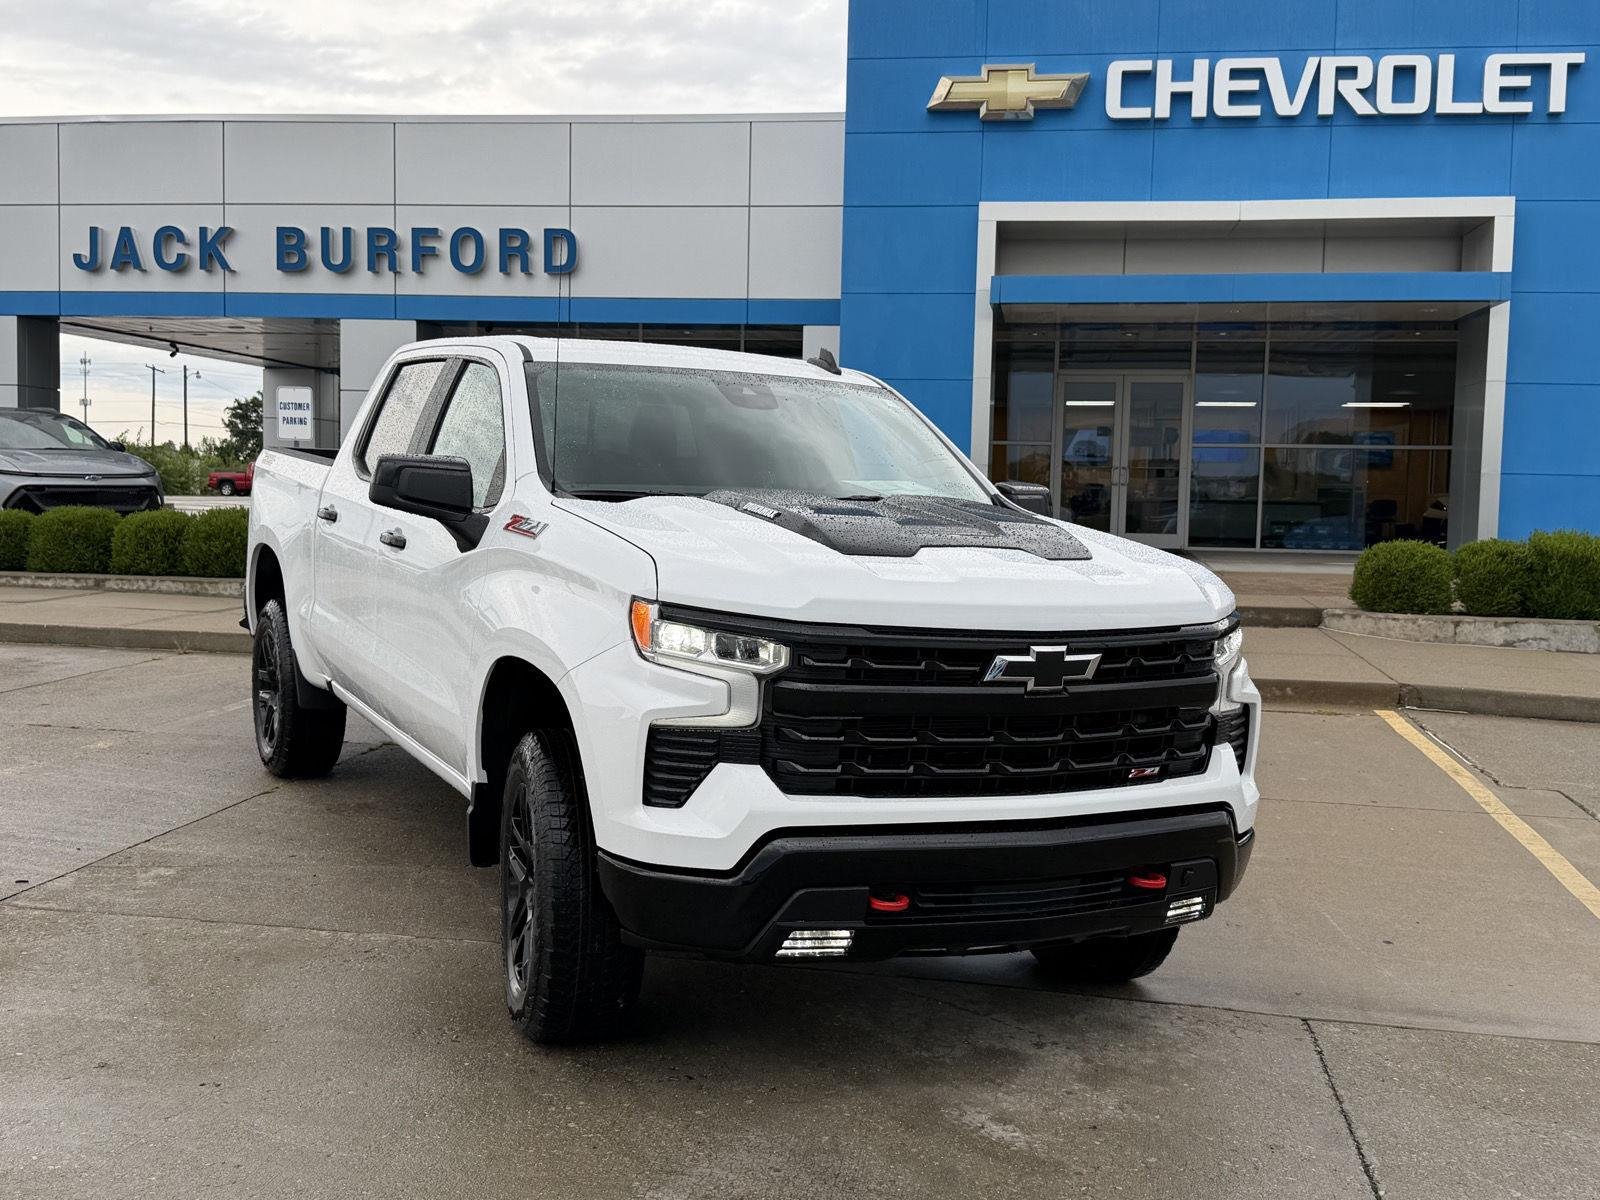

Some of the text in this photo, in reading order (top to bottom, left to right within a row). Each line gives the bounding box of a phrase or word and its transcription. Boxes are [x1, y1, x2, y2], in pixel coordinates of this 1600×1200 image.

[1105, 52, 1586, 120] CHEVROLET
[72, 225, 578, 274] JACK BURFORD
[279, 401, 310, 411] CUSTOMER
[282, 416, 308, 426] PARKING
[503, 514, 549, 540] Z71
